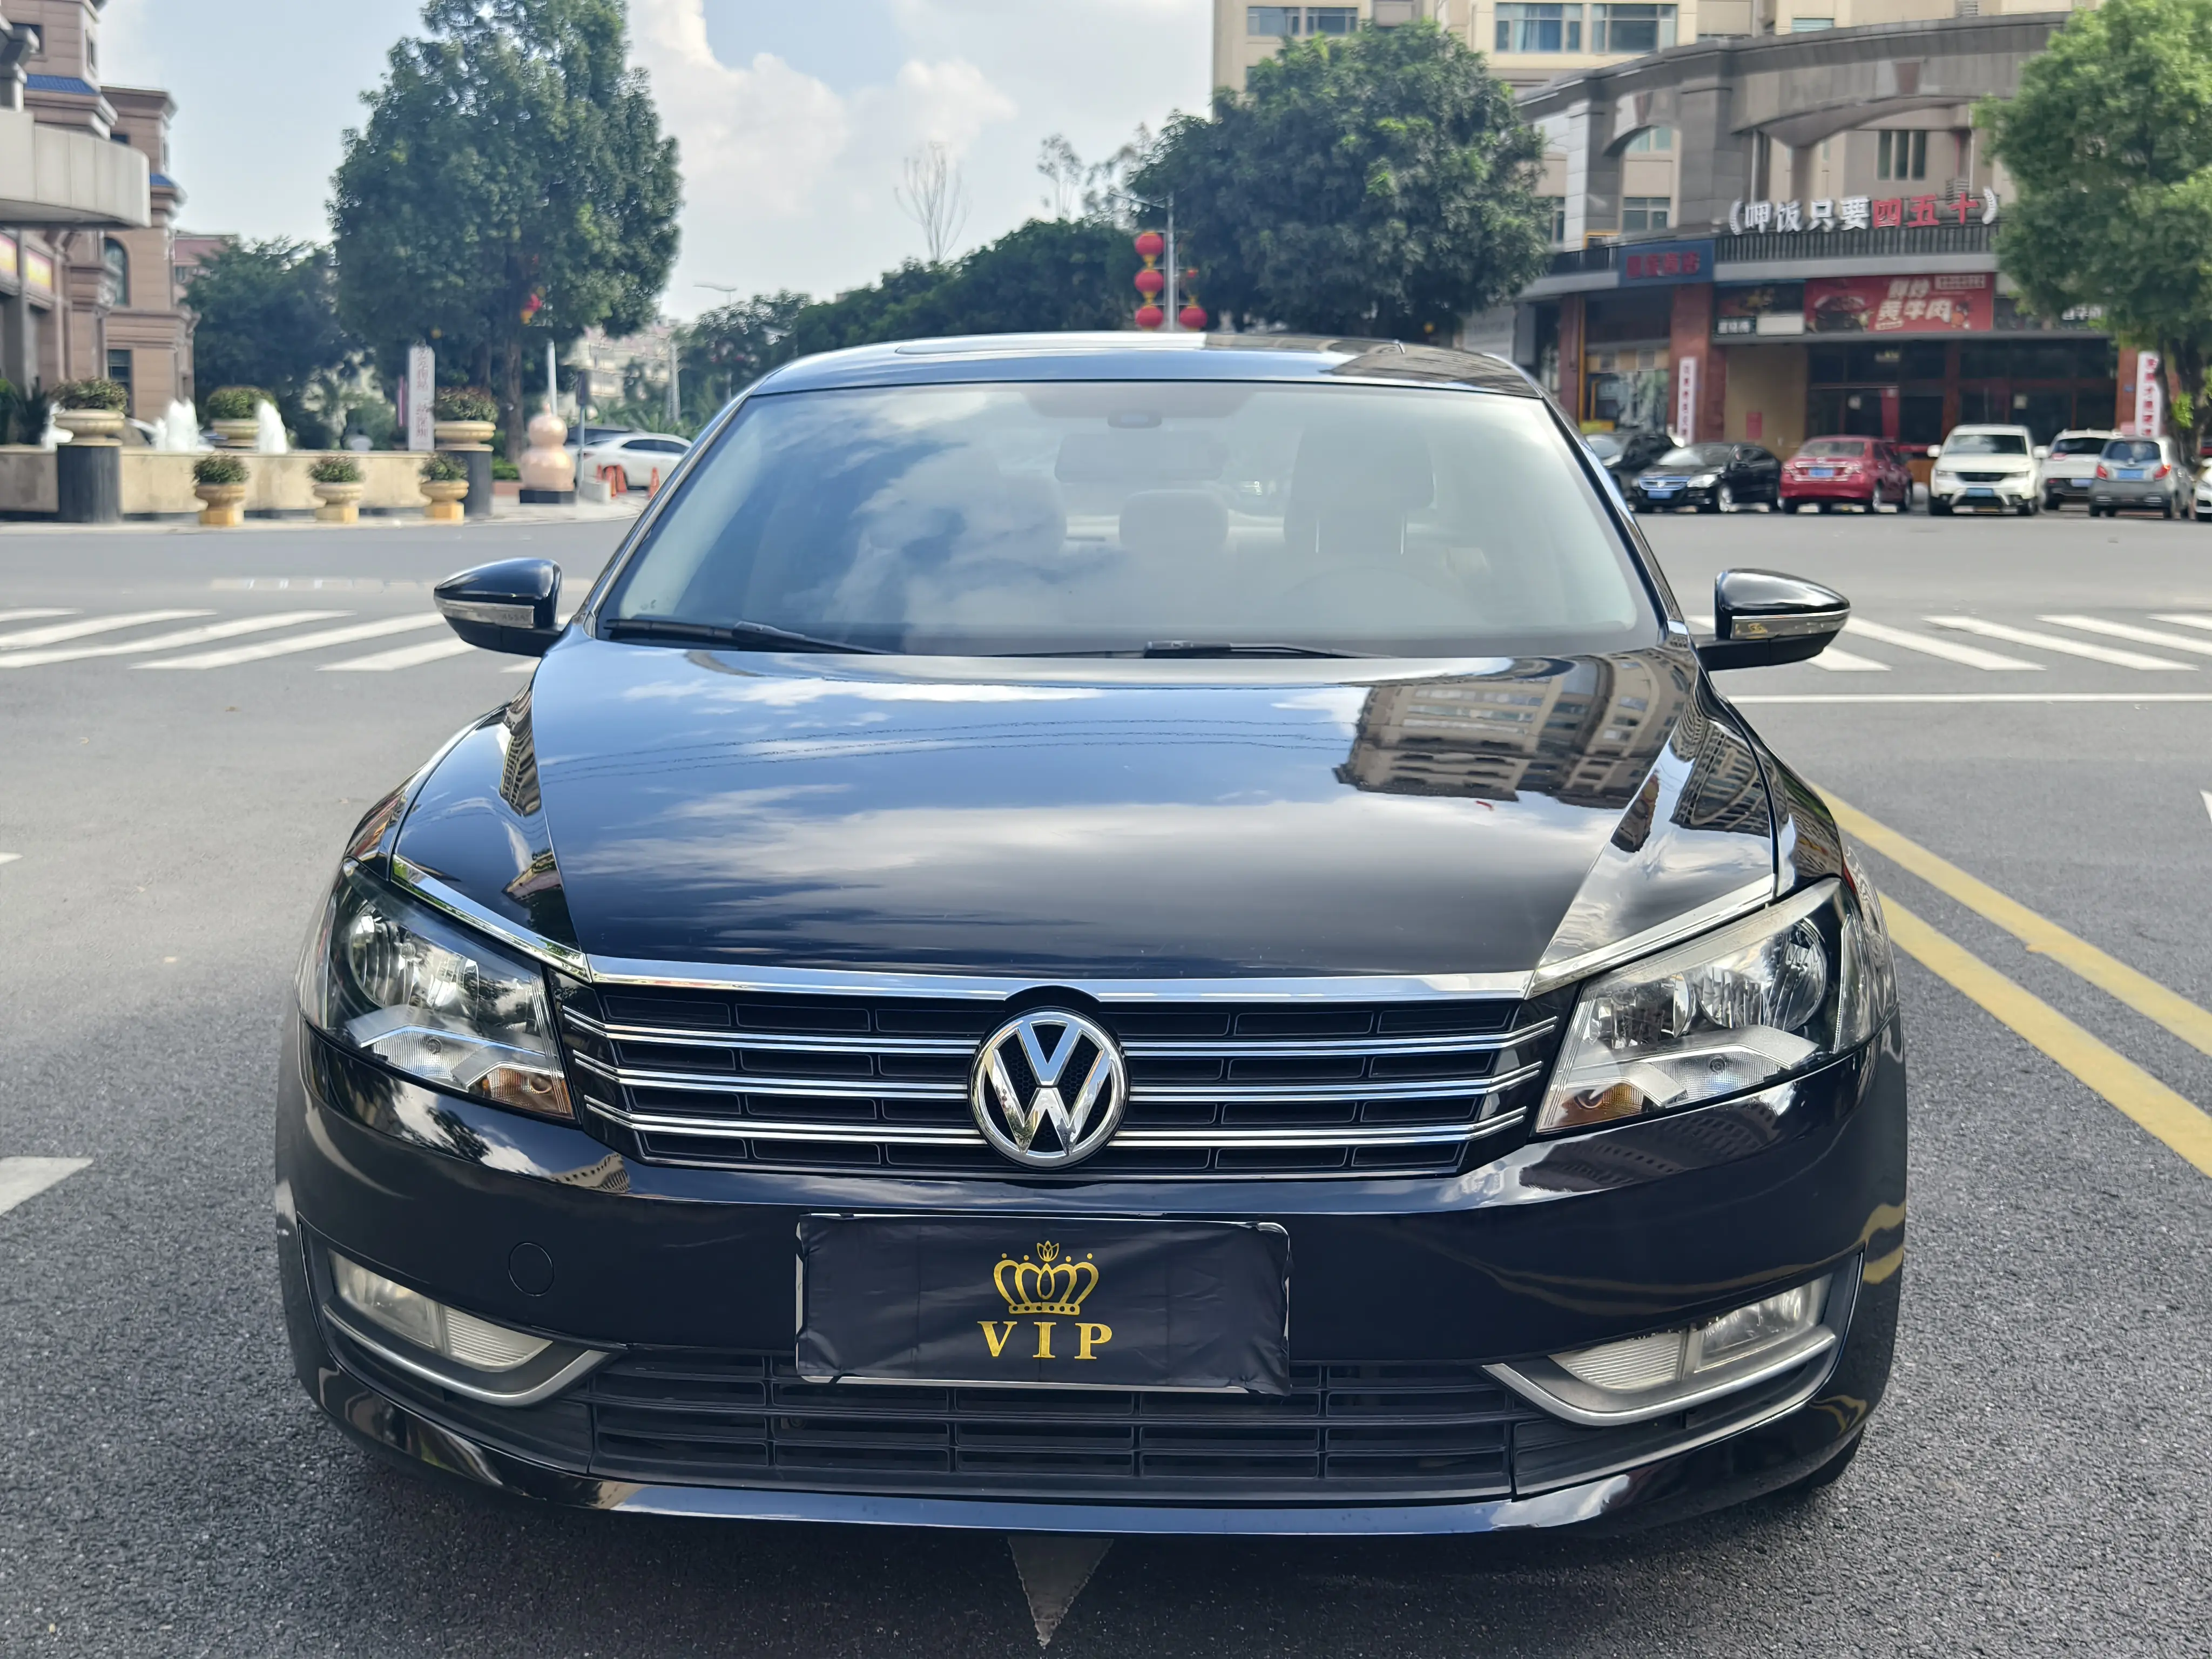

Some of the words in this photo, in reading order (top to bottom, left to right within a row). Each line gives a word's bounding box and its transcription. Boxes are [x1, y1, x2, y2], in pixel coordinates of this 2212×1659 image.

[1877, 300, 1953, 323] 黄牛肉
[977, 1320, 1113, 1360] VIP
